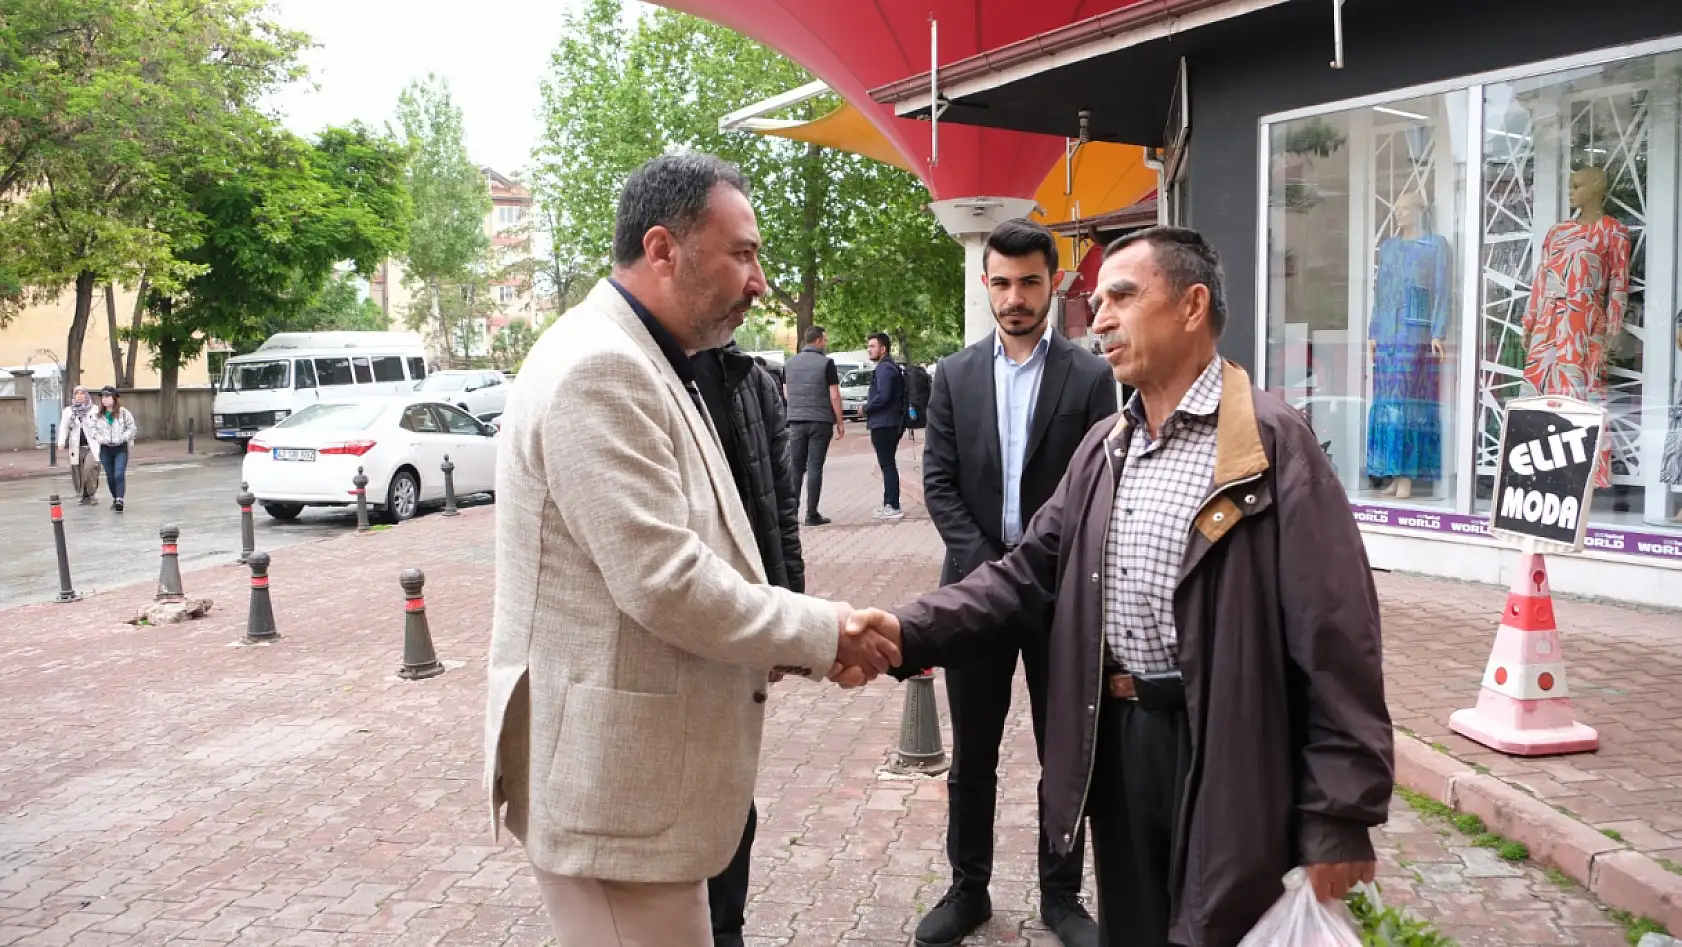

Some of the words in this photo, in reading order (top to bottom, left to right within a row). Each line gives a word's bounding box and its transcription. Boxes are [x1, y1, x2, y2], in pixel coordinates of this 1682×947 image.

[1500, 486, 1578, 530] MODA
[1398, 516, 1440, 529] WORLD
[1584, 536, 1625, 549] ORLD
[1637, 541, 1682, 555] WORL
